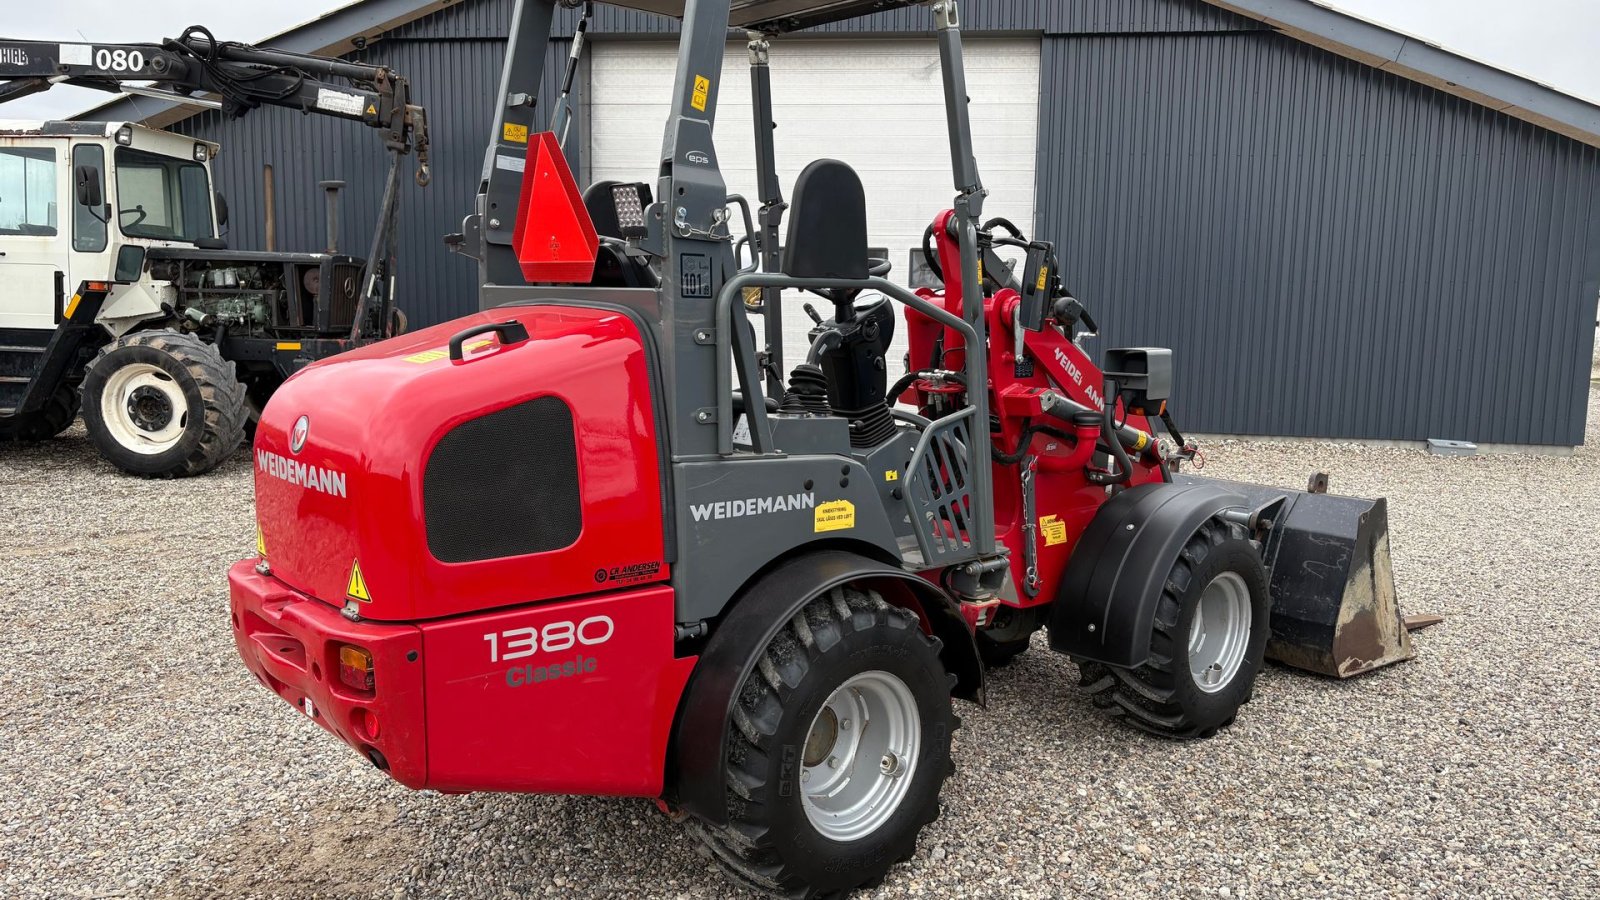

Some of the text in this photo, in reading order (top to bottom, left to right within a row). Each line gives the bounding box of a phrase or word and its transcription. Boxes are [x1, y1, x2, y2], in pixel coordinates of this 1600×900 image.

[96, 49, 144, 72] 080
[684, 272, 702, 295] 101
[257, 447, 347, 499] WEIDEMANN
[689, 492, 815, 522] WEIDEMANN
[621, 561, 661, 574] ANDERSEN
[483, 614, 615, 663] 1380
[505, 654, 598, 688] Classic
